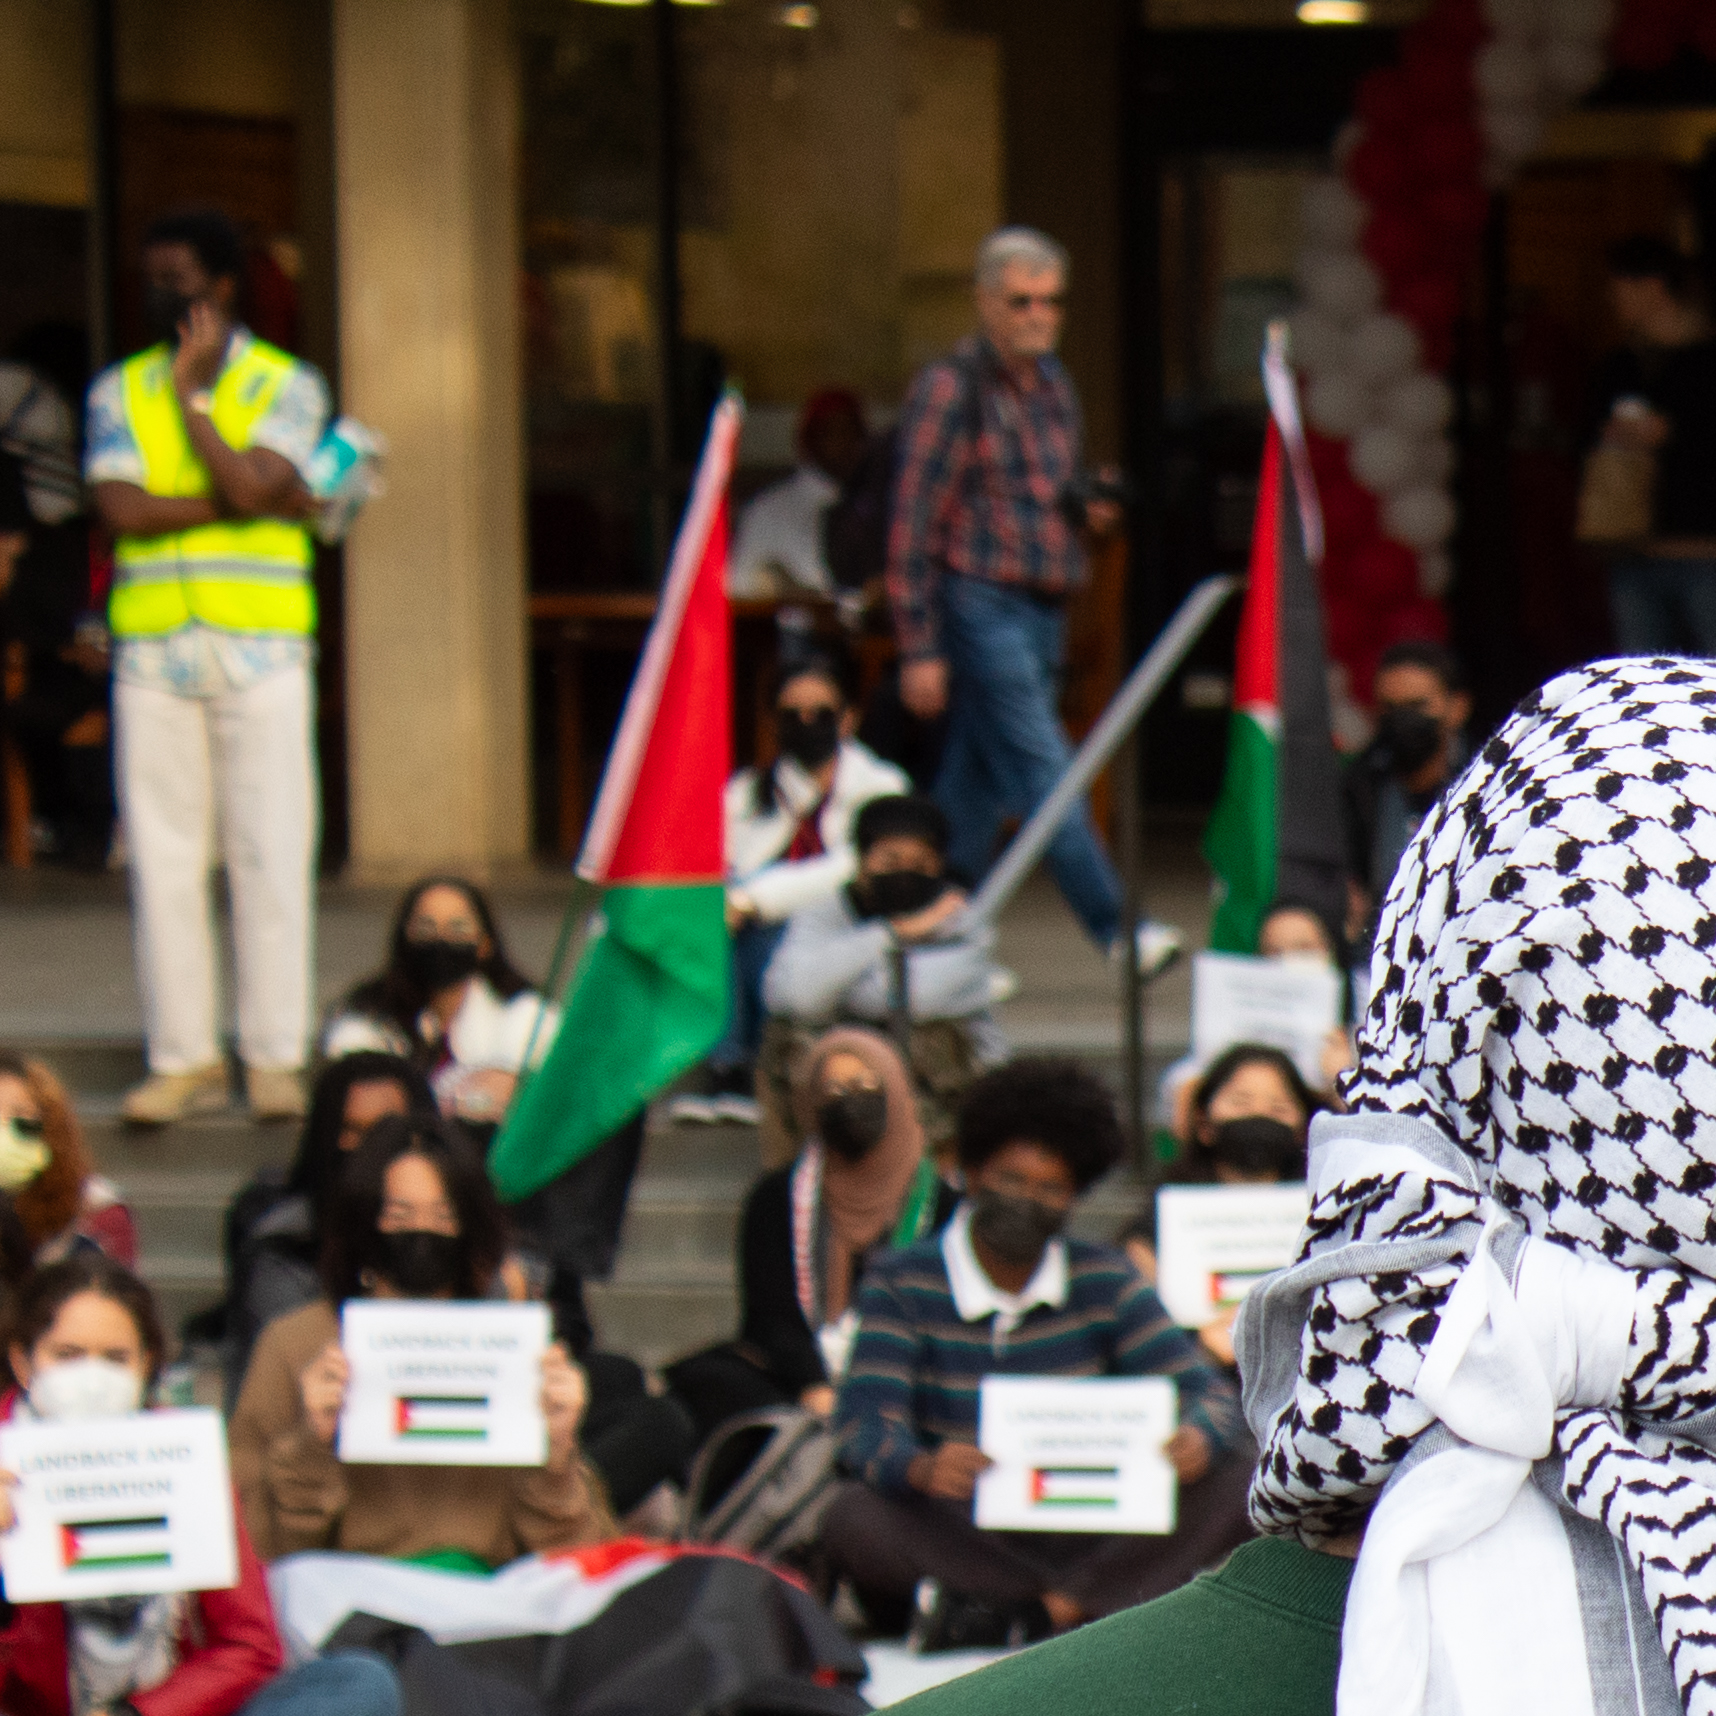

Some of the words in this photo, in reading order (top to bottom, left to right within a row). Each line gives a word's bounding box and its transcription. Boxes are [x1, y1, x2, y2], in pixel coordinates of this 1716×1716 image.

[20, 1445, 139, 1475] LANDBACK
[147, 1443, 192, 1464] AND
[44, 1477, 174, 1505] LIBERATION
